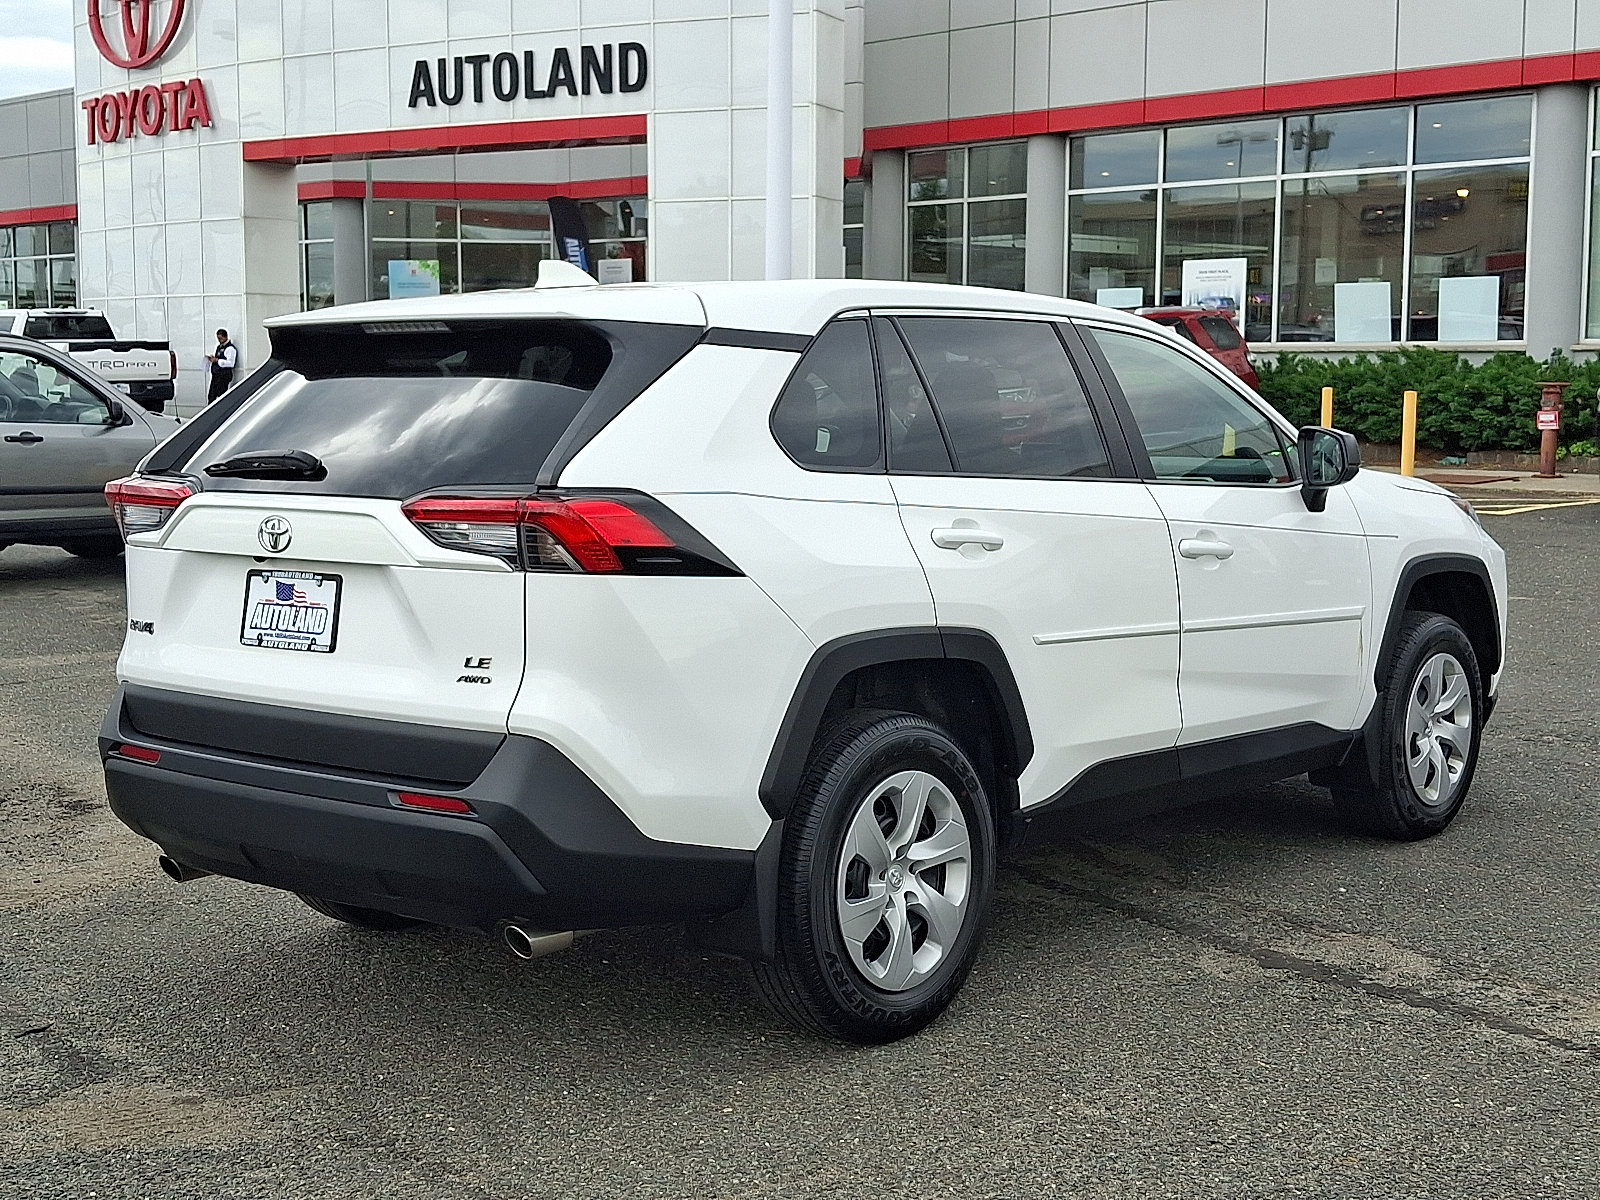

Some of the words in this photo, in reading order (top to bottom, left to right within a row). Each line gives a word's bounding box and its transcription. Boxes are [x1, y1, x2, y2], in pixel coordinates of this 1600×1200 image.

[408, 42, 648, 108] AUTOLAND
[82, 78, 211, 145] TOYOTA
[250, 603, 328, 634] AUTOLAND
[261, 640, 308, 650] AUTOLAND
[463, 656, 493, 670] LE
[455, 675, 493, 684] AWD
